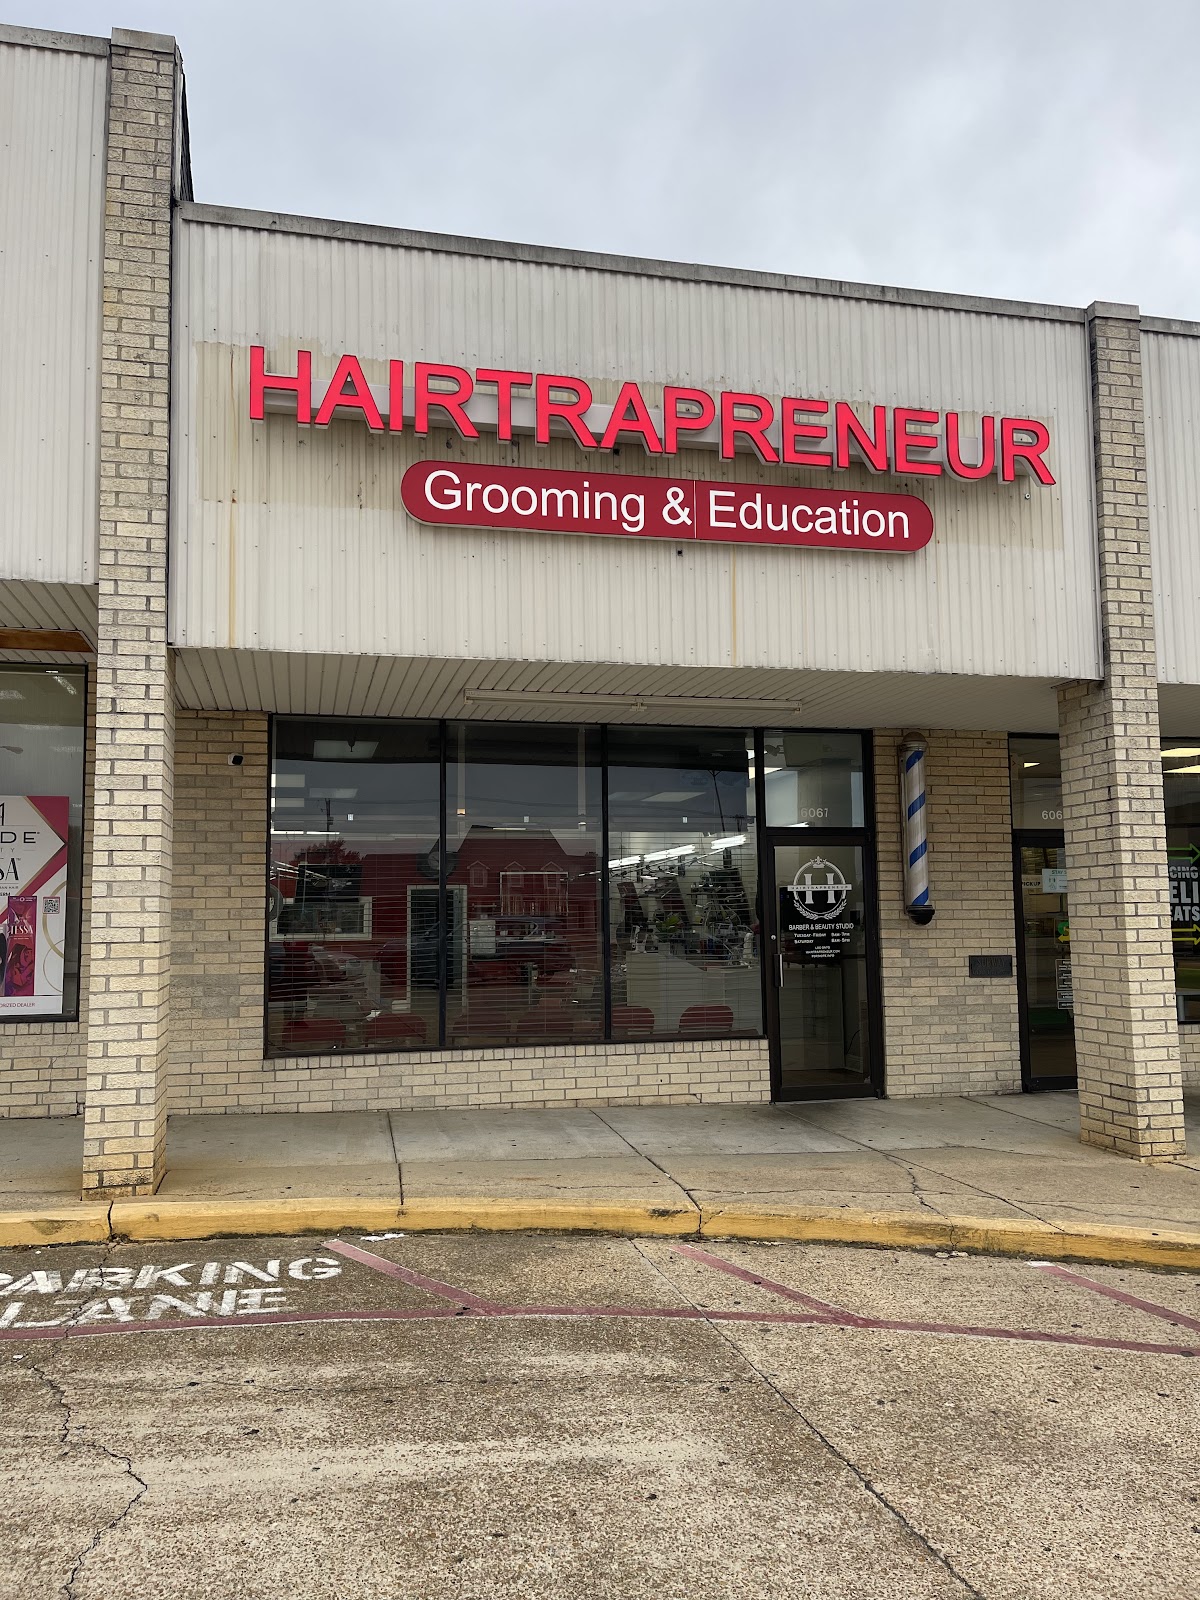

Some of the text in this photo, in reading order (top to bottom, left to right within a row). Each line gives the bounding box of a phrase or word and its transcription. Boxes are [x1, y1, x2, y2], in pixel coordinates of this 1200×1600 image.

[250, 346, 1056, 485] HAIRTRAPRENEUR
[423, 469, 910, 540] Grooming & Education
[1171, 905, 1200, 922] ATS
